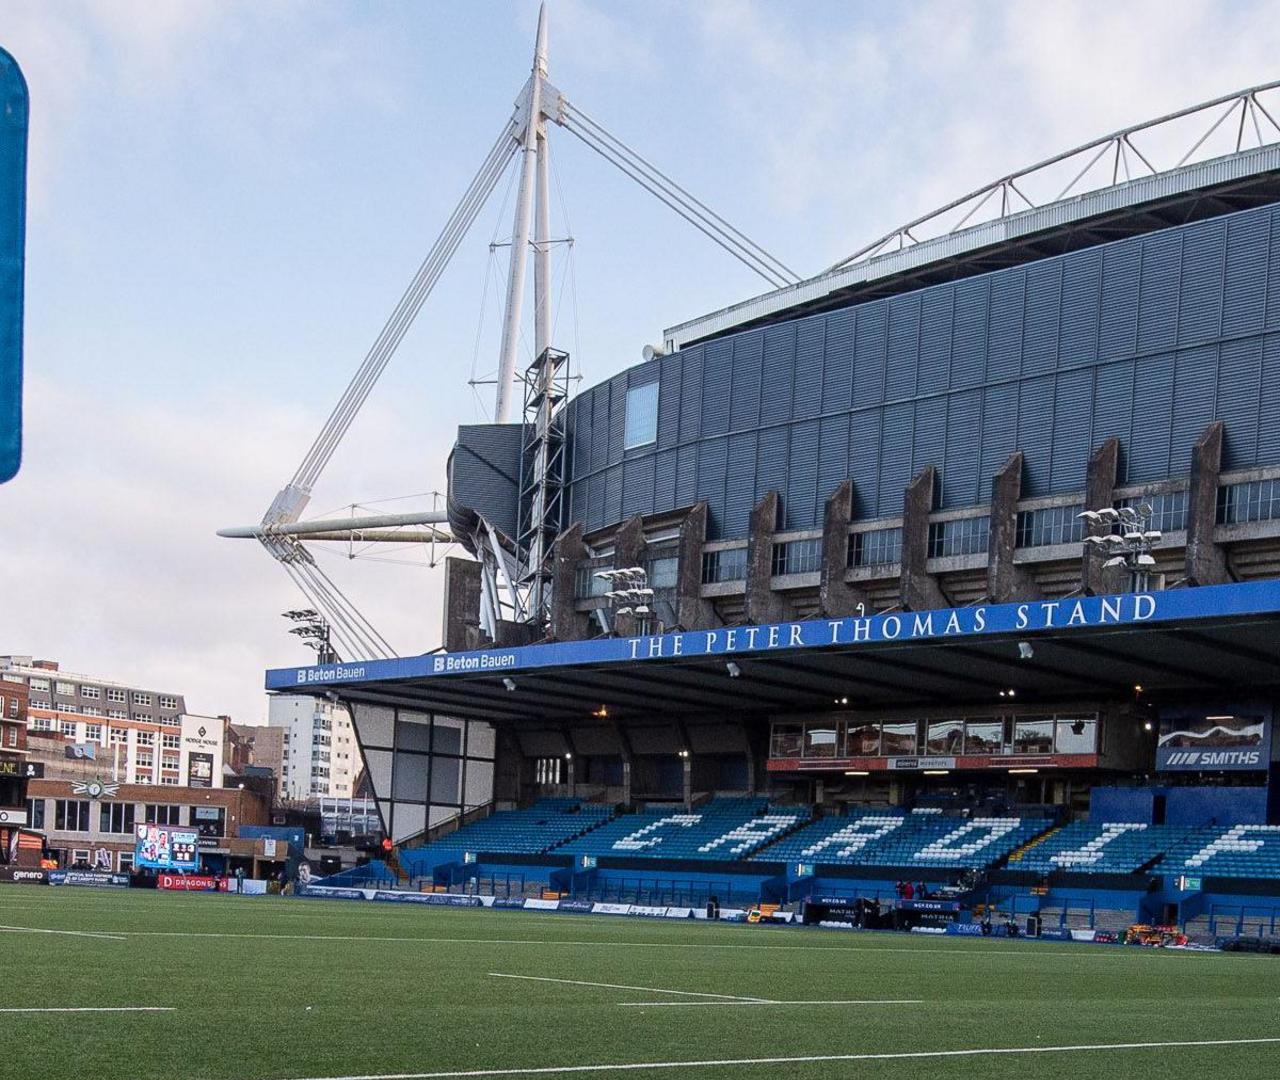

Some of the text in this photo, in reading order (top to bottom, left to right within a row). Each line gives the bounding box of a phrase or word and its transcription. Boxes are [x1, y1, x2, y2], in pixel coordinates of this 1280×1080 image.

[628, 595, 1157, 659] THE PETER THOMAS STAND
[446, 656, 479, 671] Beton
[480, 653, 515, 669] Bauen
[308, 669, 335, 682] Beton
[336, 667, 365, 680] Bauen
[1200, 752, 1260, 765] SMITHS
[13, 871, 43, 880] genero
